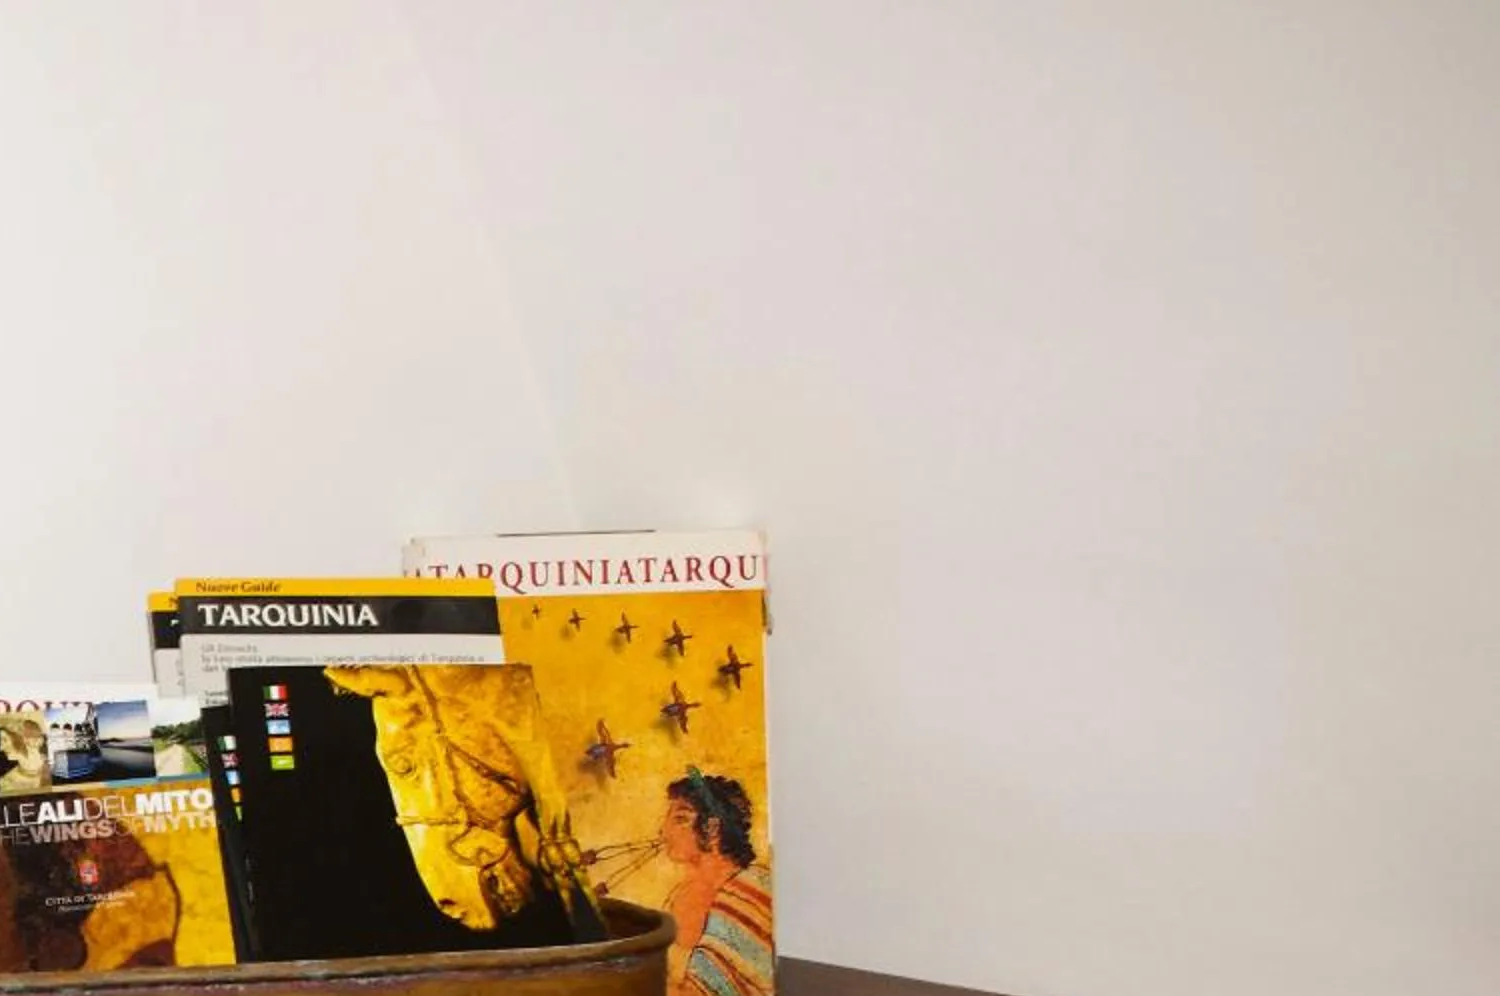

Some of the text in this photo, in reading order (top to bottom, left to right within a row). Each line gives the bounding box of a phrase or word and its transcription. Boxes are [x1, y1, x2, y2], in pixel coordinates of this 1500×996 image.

[196, 581, 282, 593] Nuove Guide
[197, 602, 379, 627] TARQUINIA
